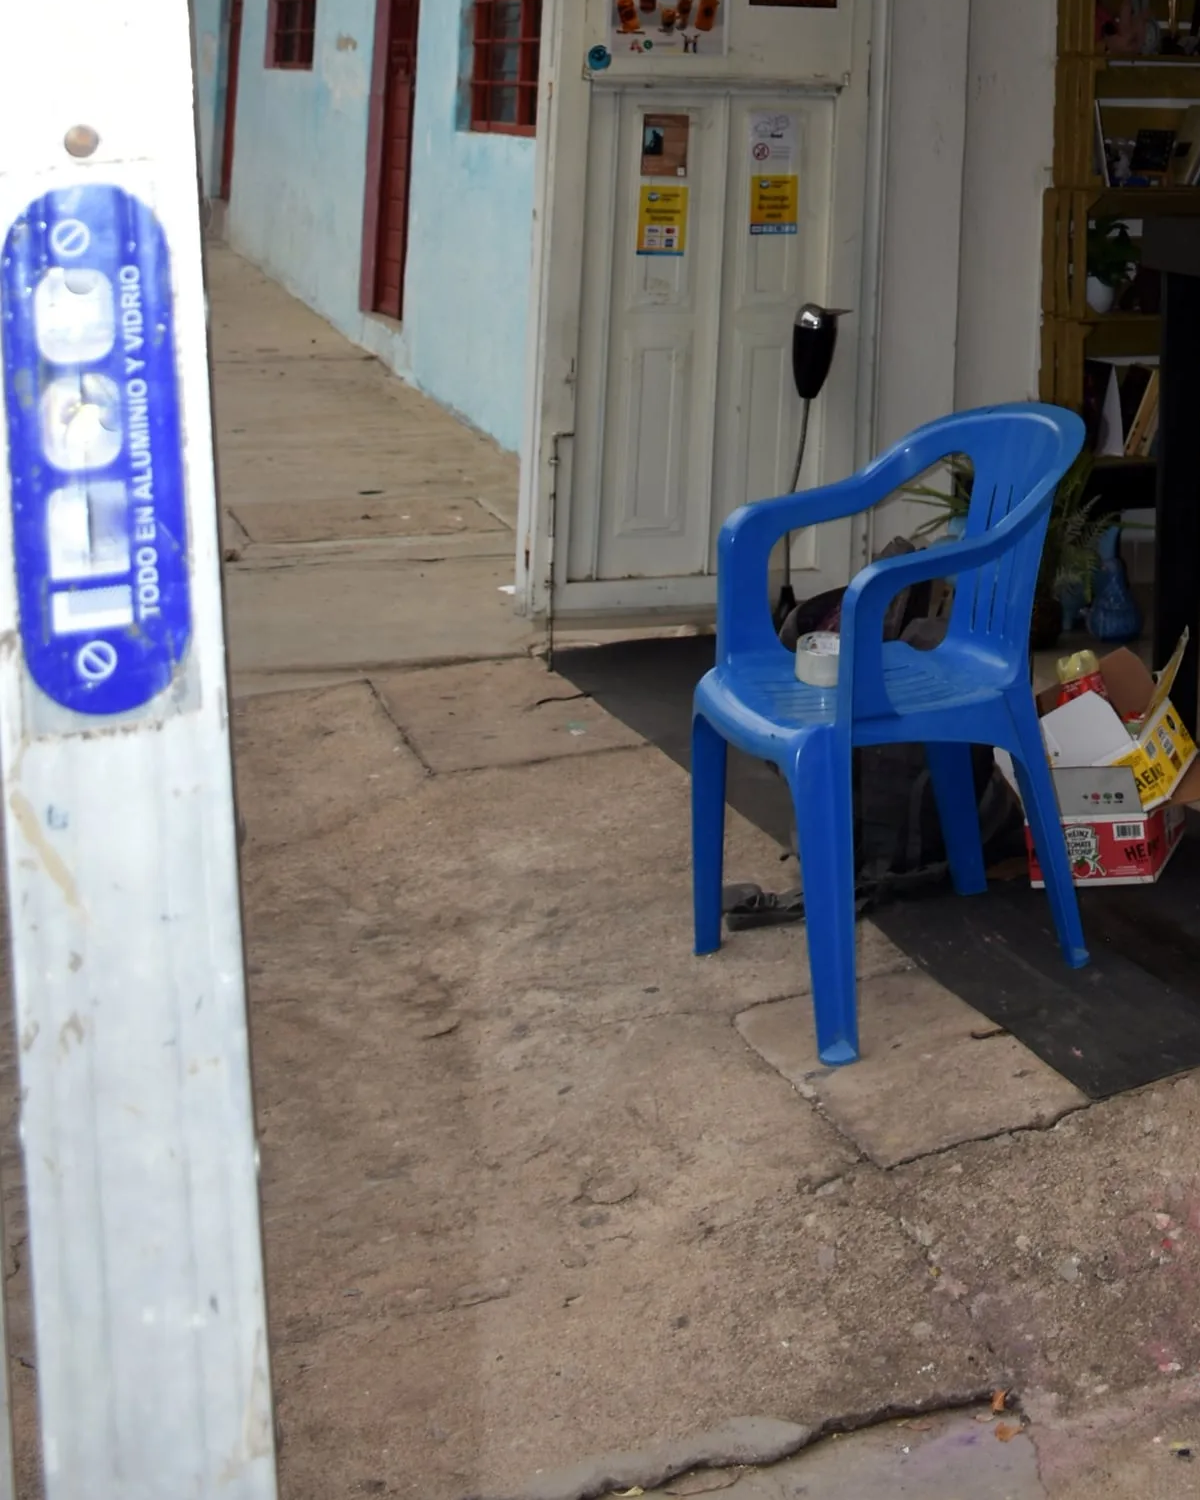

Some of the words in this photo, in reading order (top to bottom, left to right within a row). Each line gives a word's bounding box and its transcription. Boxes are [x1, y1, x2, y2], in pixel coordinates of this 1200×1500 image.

[119, 264, 145, 351] VIDRIO
[126, 357, 146, 374] Y
[127, 379, 154, 500] ALUMINIO
[135, 506, 157, 542] EN
[136, 545, 161, 621] TODO
